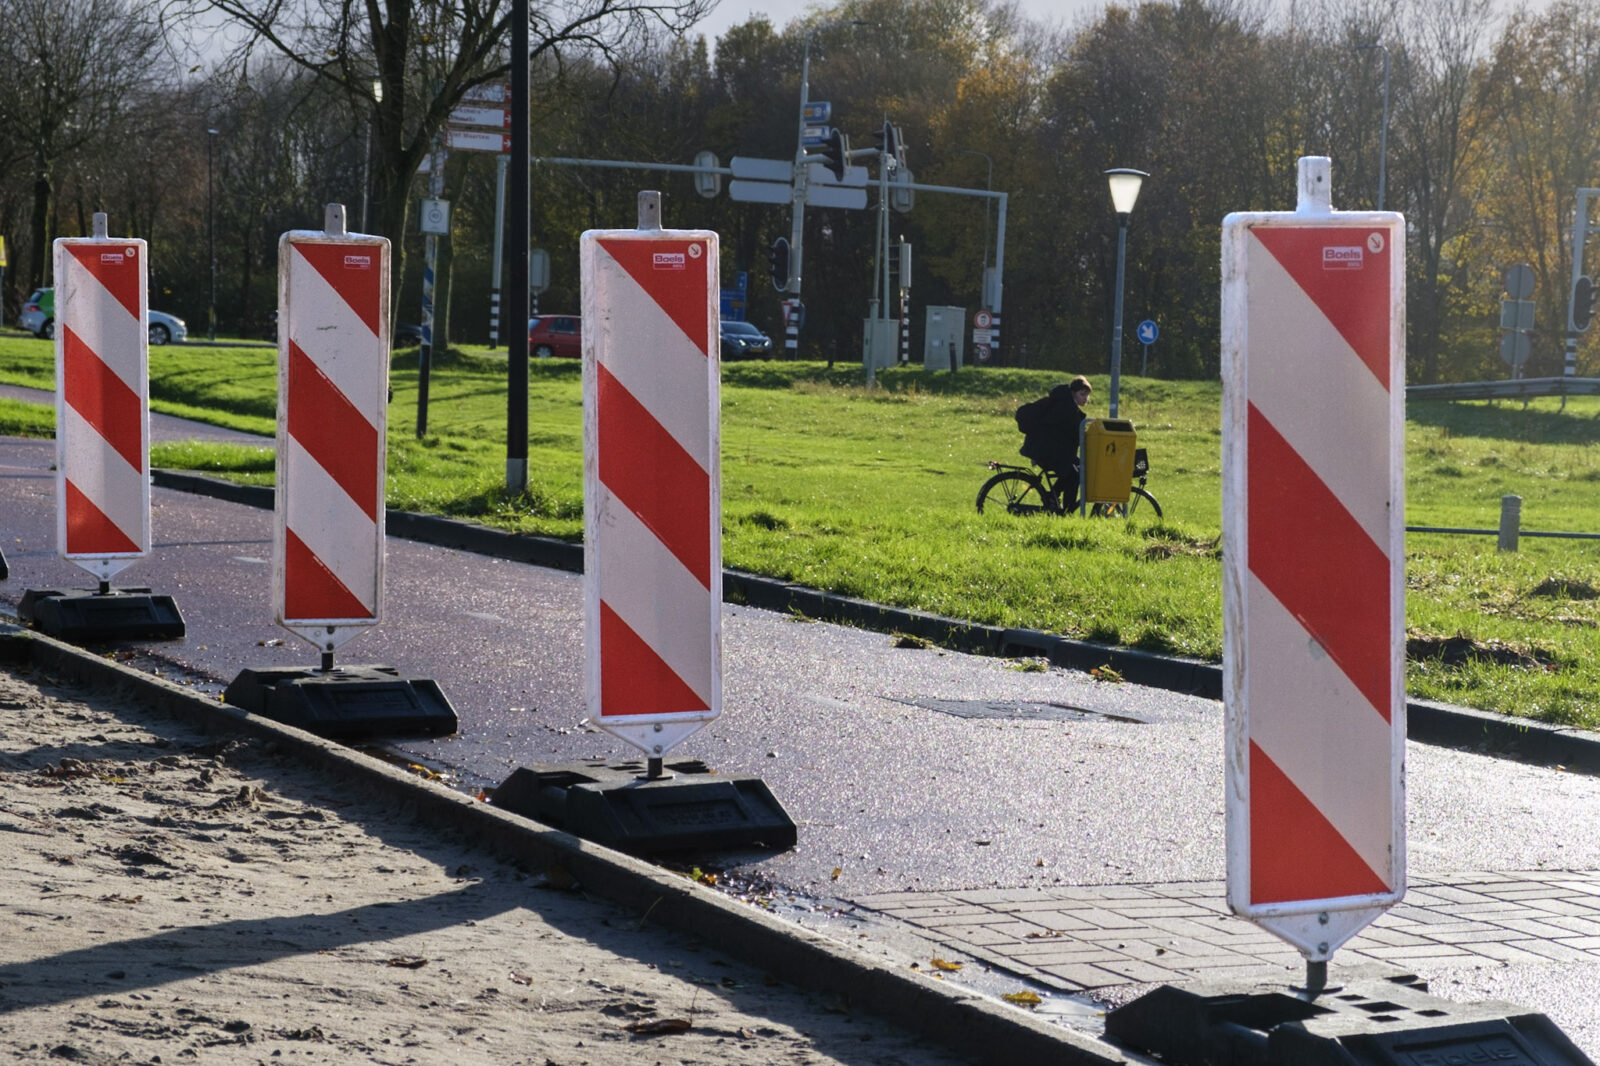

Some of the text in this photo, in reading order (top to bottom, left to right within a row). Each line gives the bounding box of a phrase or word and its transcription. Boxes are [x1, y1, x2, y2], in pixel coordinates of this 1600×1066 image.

[1325, 249, 1361, 259] Boels
[346, 256, 369, 264] Boels
[655, 255, 683, 263] Boels
